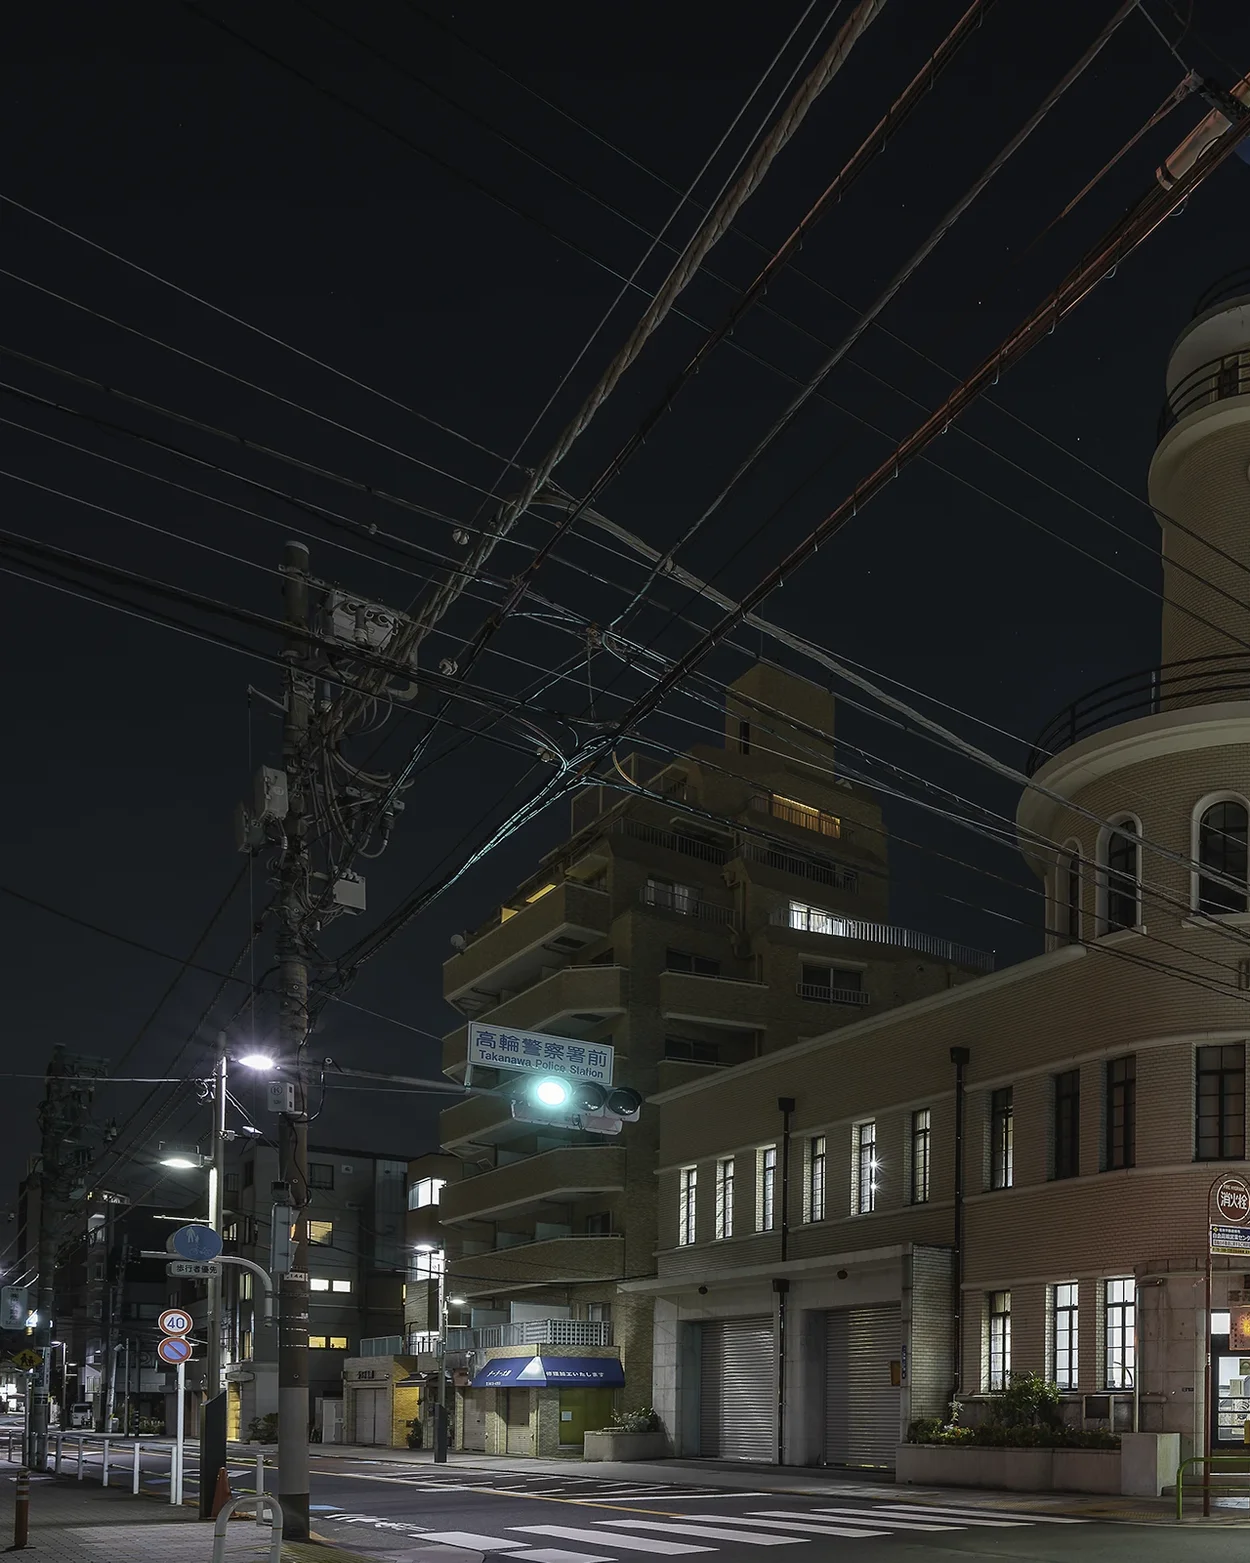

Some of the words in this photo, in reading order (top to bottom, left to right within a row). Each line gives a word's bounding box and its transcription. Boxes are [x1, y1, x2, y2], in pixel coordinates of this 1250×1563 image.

[476, 1030, 608, 1067] 高輪警察署前
[478, 1049, 531, 1067] Takanawa
[536, 1059, 566, 1073] Police
[569, 1064, 603, 1078] Station
[1220, 1191, 1248, 1210] 消火栓
[176, 1264, 218, 1274] 歩行者優先
[166, 1317, 185, 1329] 40
